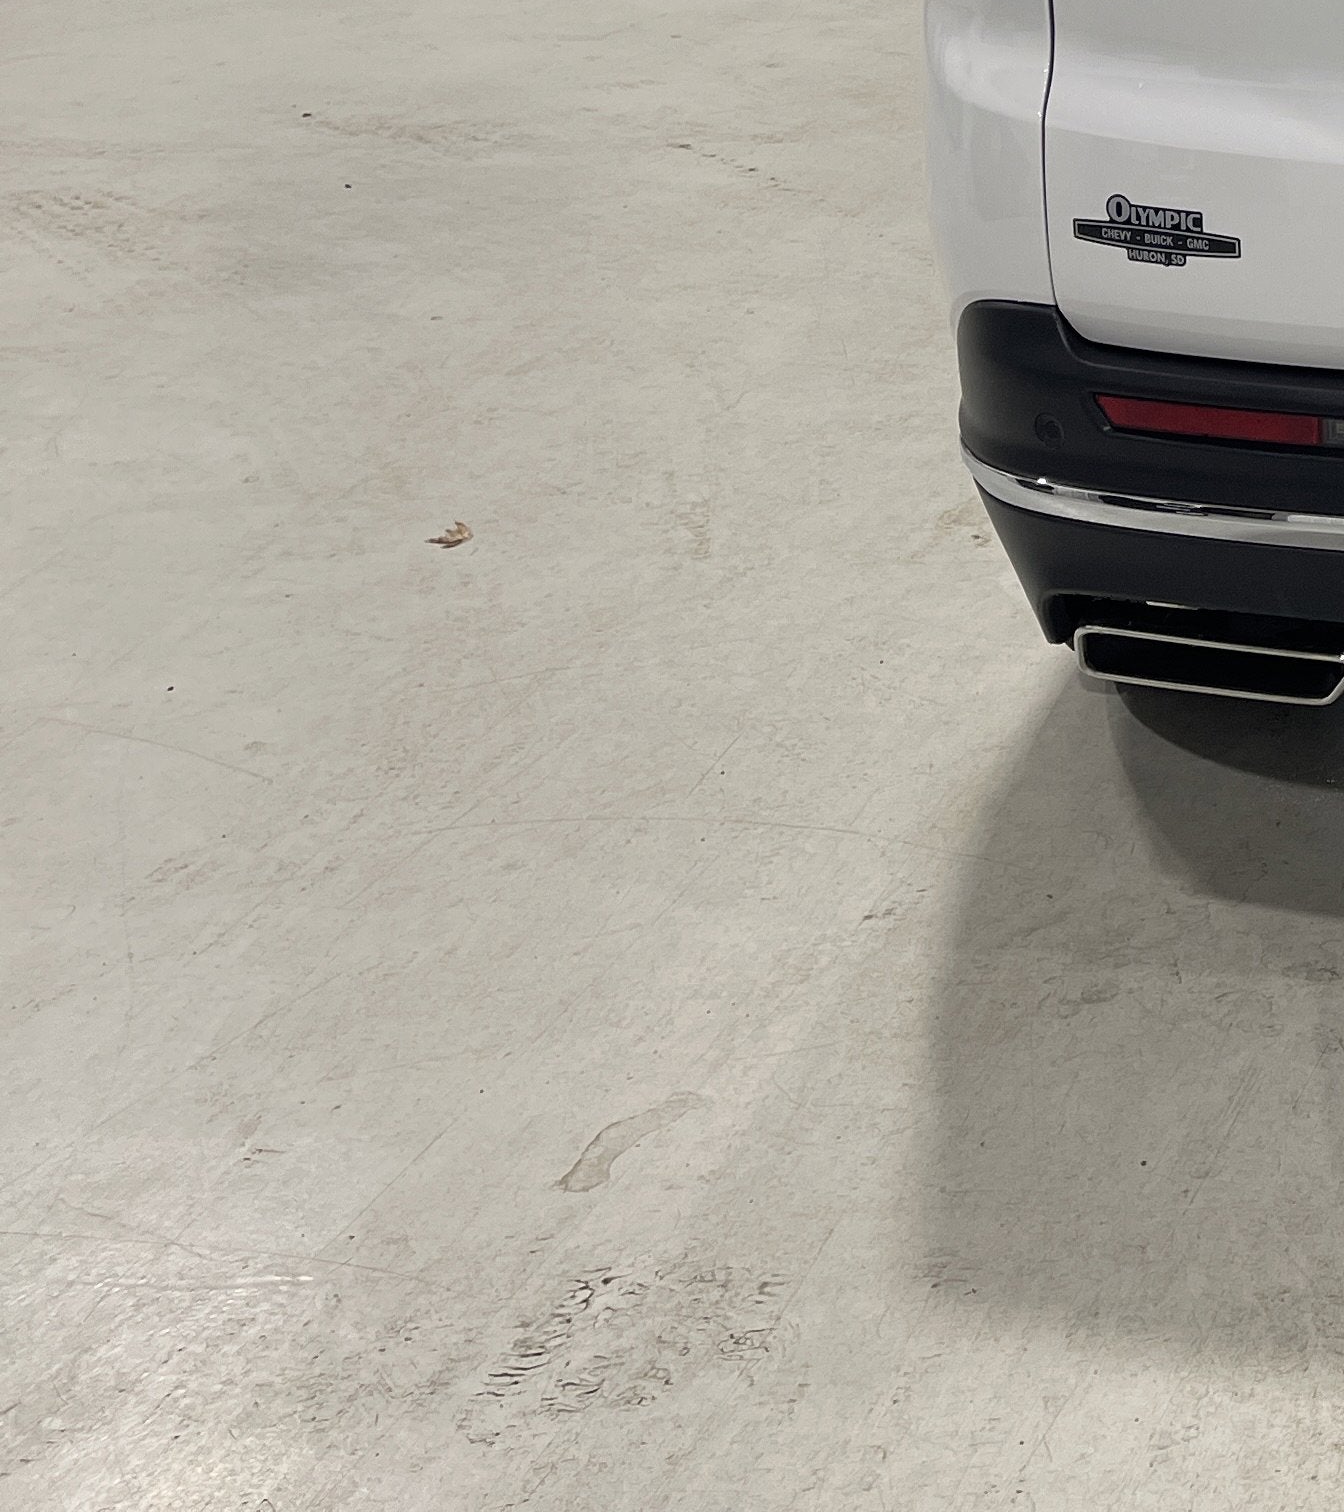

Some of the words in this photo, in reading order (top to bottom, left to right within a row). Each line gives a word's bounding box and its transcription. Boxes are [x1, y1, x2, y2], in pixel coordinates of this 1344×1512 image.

[1107, 195, 1201, 232] OLYMPIC
[1101, 228, 1132, 241] CHEVY
[1144, 233, 1174, 247] BUICK
[1187, 238, 1210, 251] GMC
[1128, 249, 1169, 265] HURON,
[1171, 254, 1185, 265] SD
